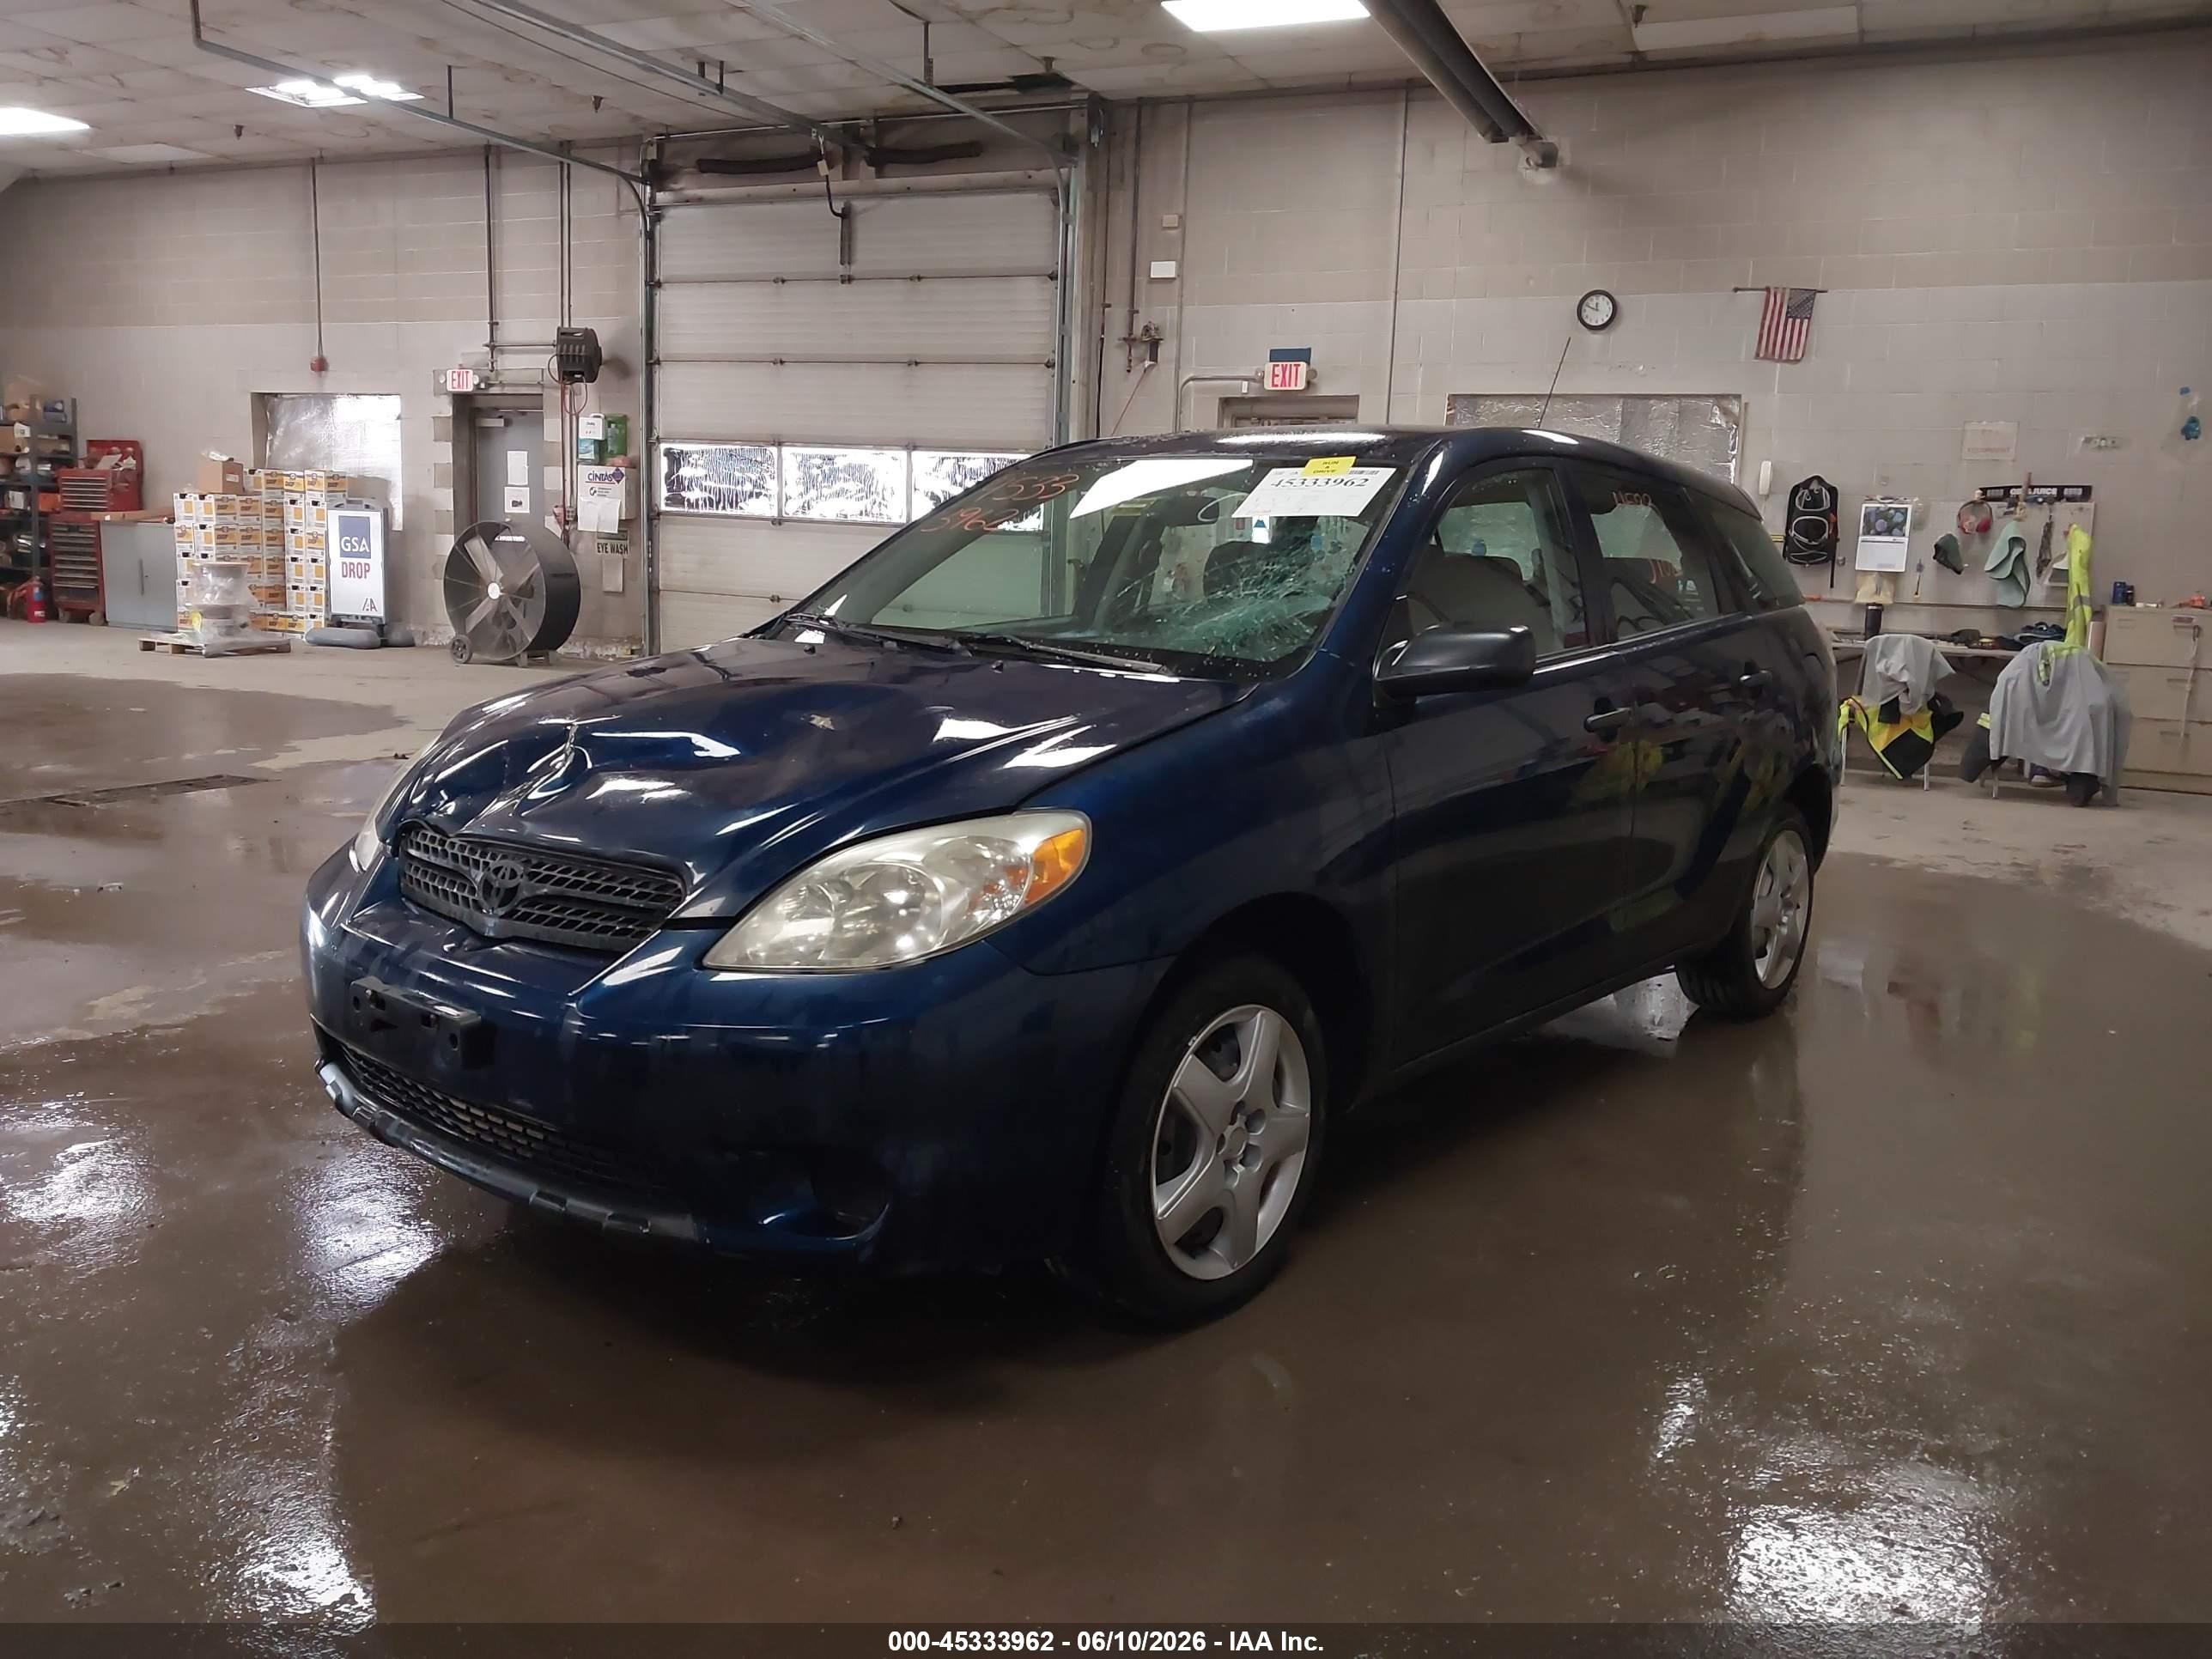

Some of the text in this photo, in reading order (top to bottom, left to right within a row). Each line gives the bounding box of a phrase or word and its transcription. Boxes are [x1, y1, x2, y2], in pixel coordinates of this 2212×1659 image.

[451, 370, 470, 390] EXIT
[1271, 363, 1301, 388] EXIT
[1270, 477, 1370, 489] 45333962
[341, 536, 370, 552] GSA
[597, 542, 629, 556] EYE WASH
[341, 561, 371, 580] DROP
